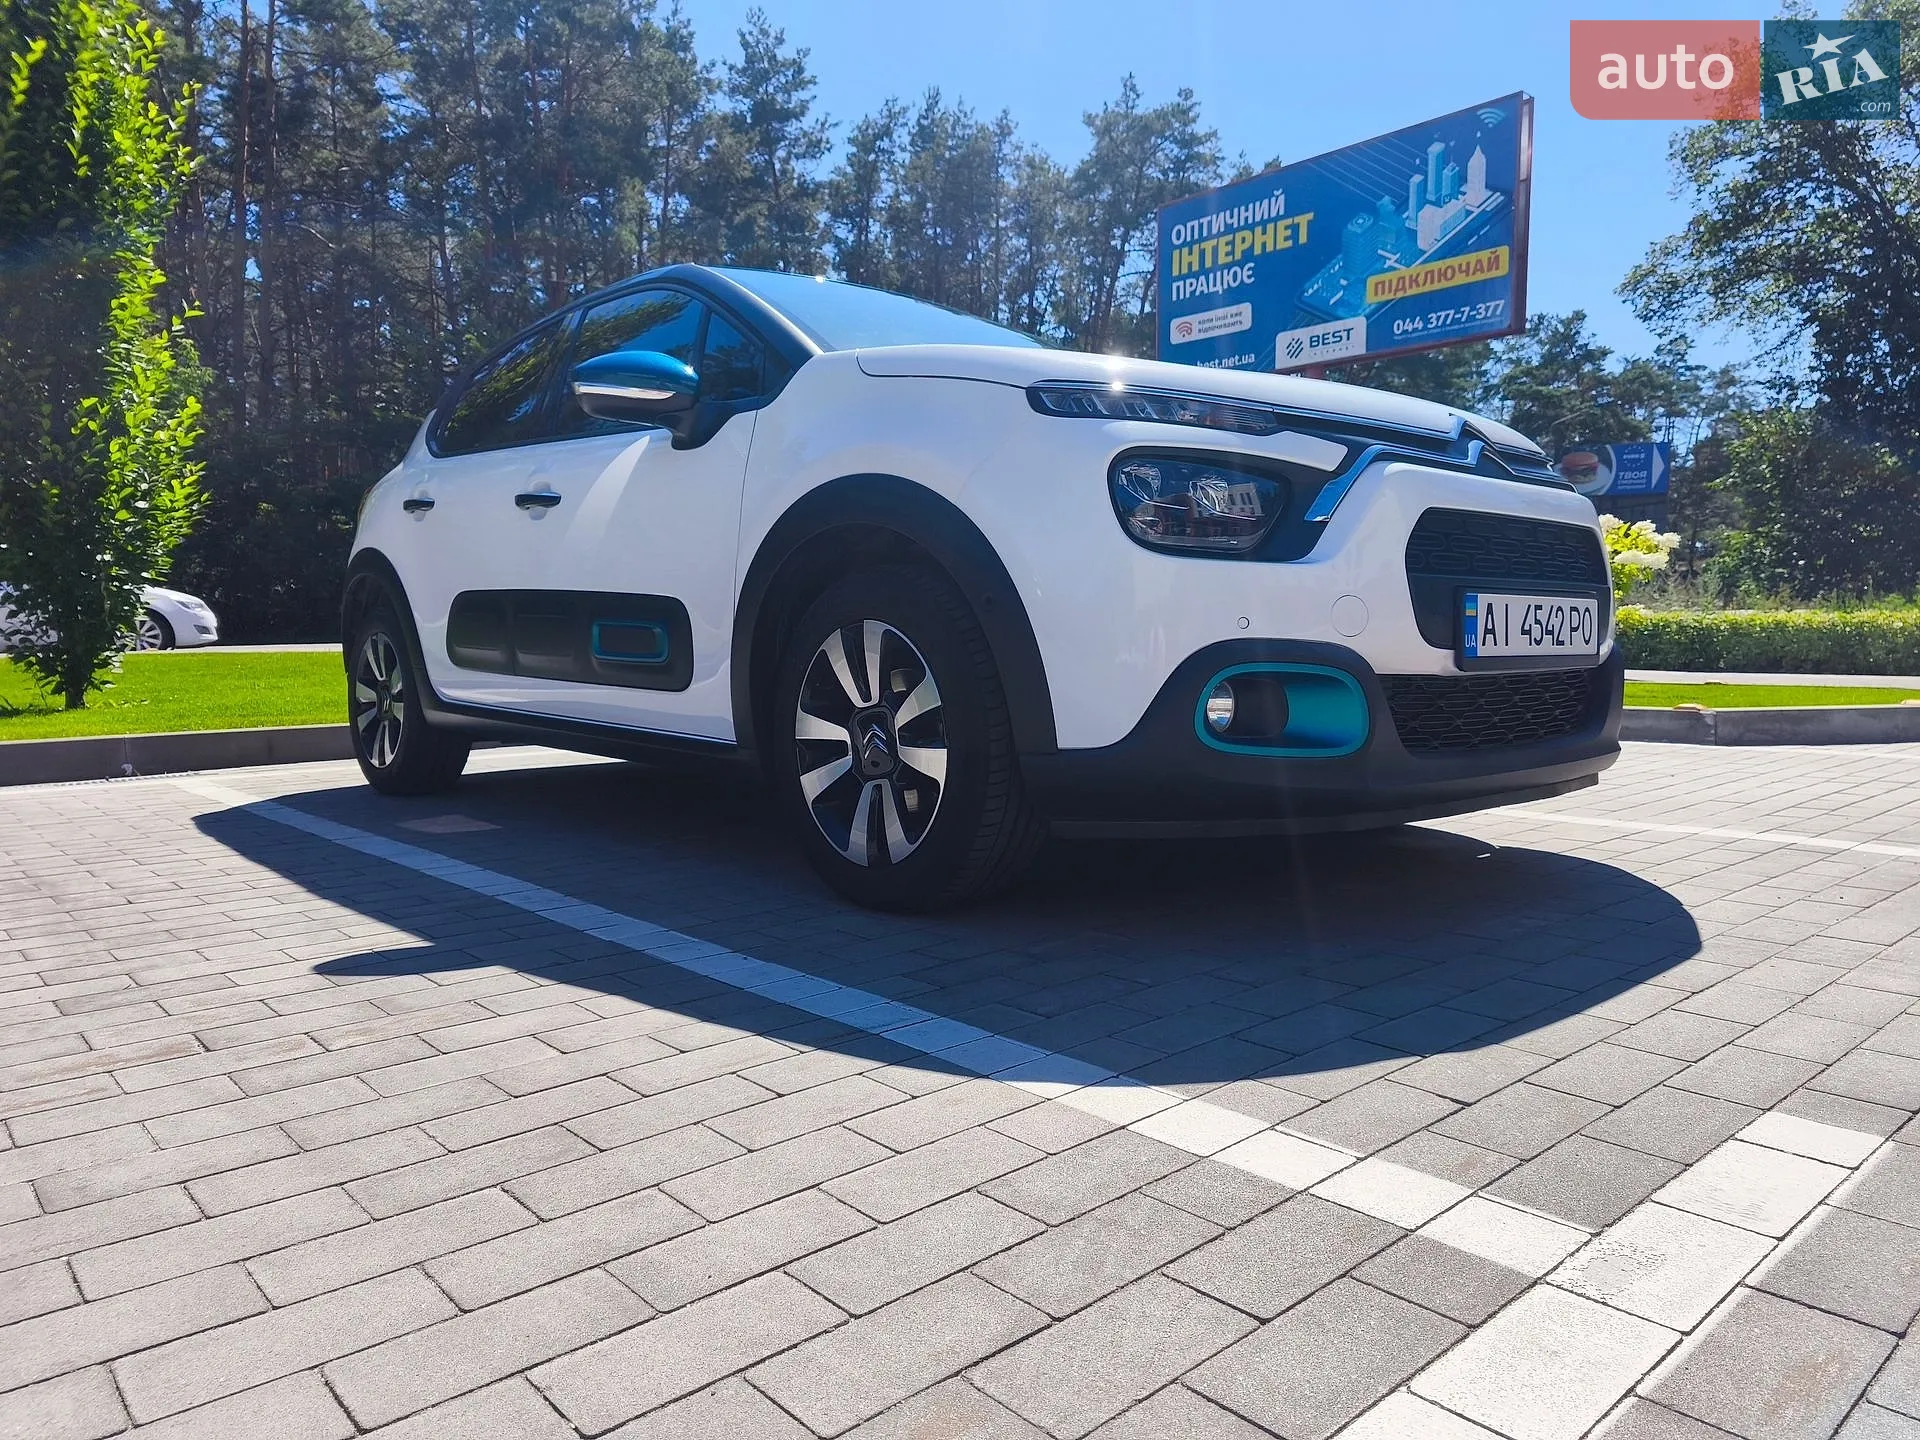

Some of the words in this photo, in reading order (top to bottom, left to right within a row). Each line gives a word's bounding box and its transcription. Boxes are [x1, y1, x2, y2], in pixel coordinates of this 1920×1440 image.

[1171, 188, 1285, 246] ОПТИЧНИЙ
[1172, 212, 1314, 277] ІНТЕРНЕТ
[1172, 262, 1255, 301] ПРАЦЮЄ
[1374, 248, 1500, 297] ПІДКЛЮЧАЙ
[1309, 327, 1354, 348] BEST
[1393, 316, 1423, 334] 044
[1427, 300, 1505, 328] 377-7-377
[1465, 634, 1476, 648] UA
[1482, 602, 1508, 646] AI
[1520, 604, 1565, 646] 4542
[1569, 606, 1592, 646] PO
